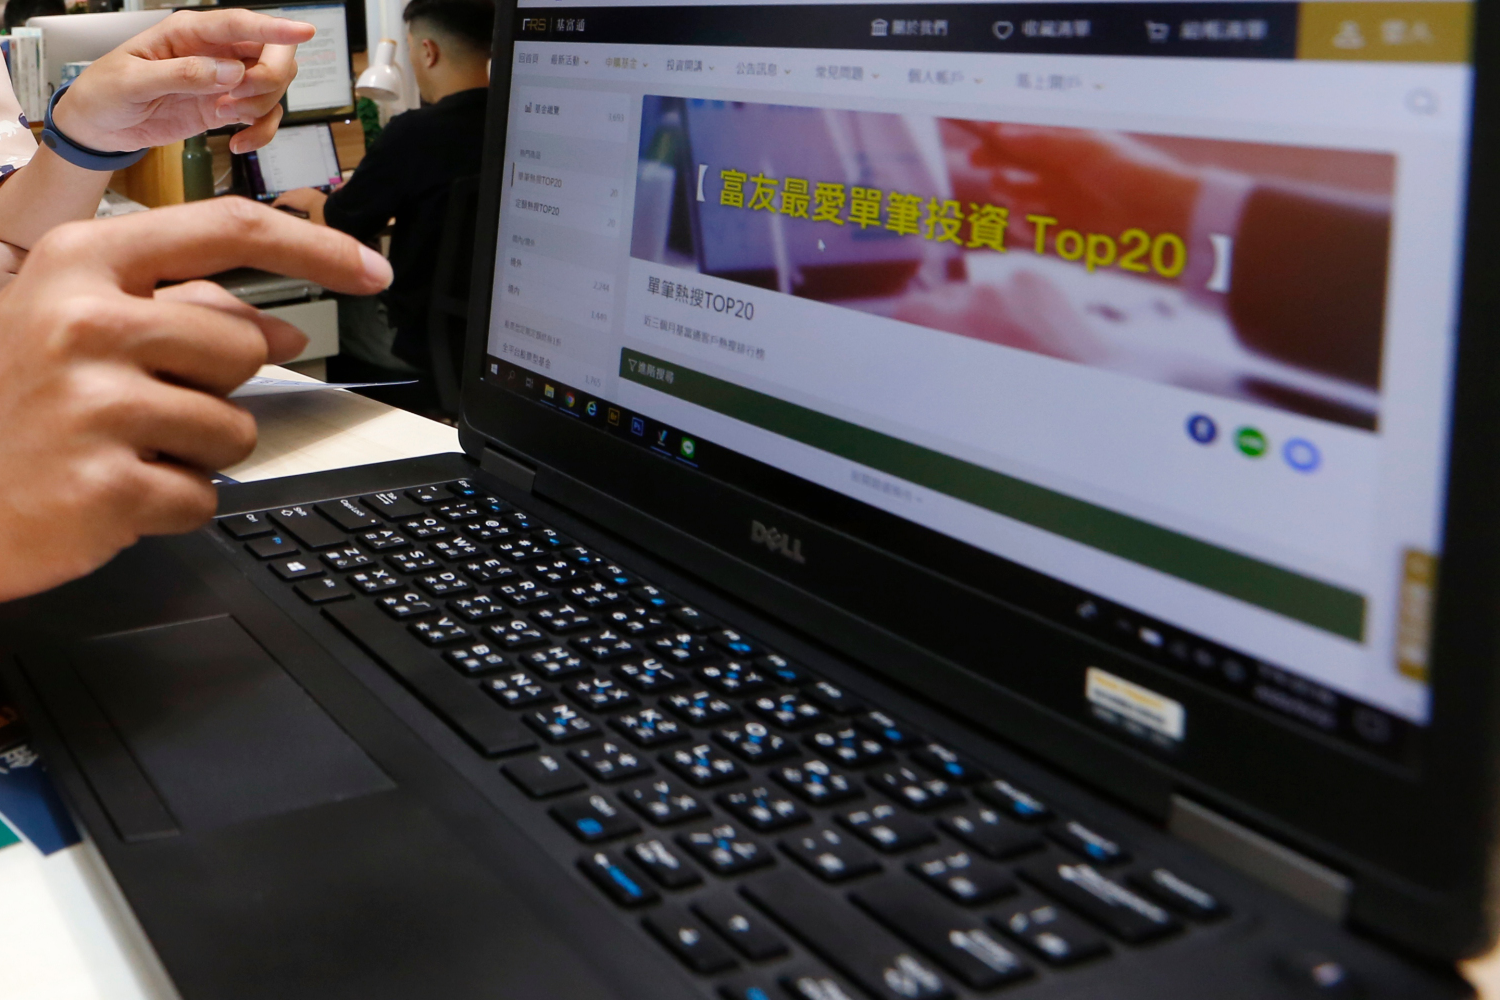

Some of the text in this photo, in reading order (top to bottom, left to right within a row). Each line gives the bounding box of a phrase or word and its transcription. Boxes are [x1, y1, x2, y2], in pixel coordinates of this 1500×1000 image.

[556, 18, 586, 32] 基富通
[518, 52, 539, 64] 回首頁
[550, 54, 580, 67] 最新活動
[605, 57, 637, 70] 申購基金
[736, 62, 777, 77] 公告訊息
[816, 65, 863, 81] 常見問題
[647, 275, 755, 321] 單筆熱搜TOP20
[751, 519, 806, 564] DELL
